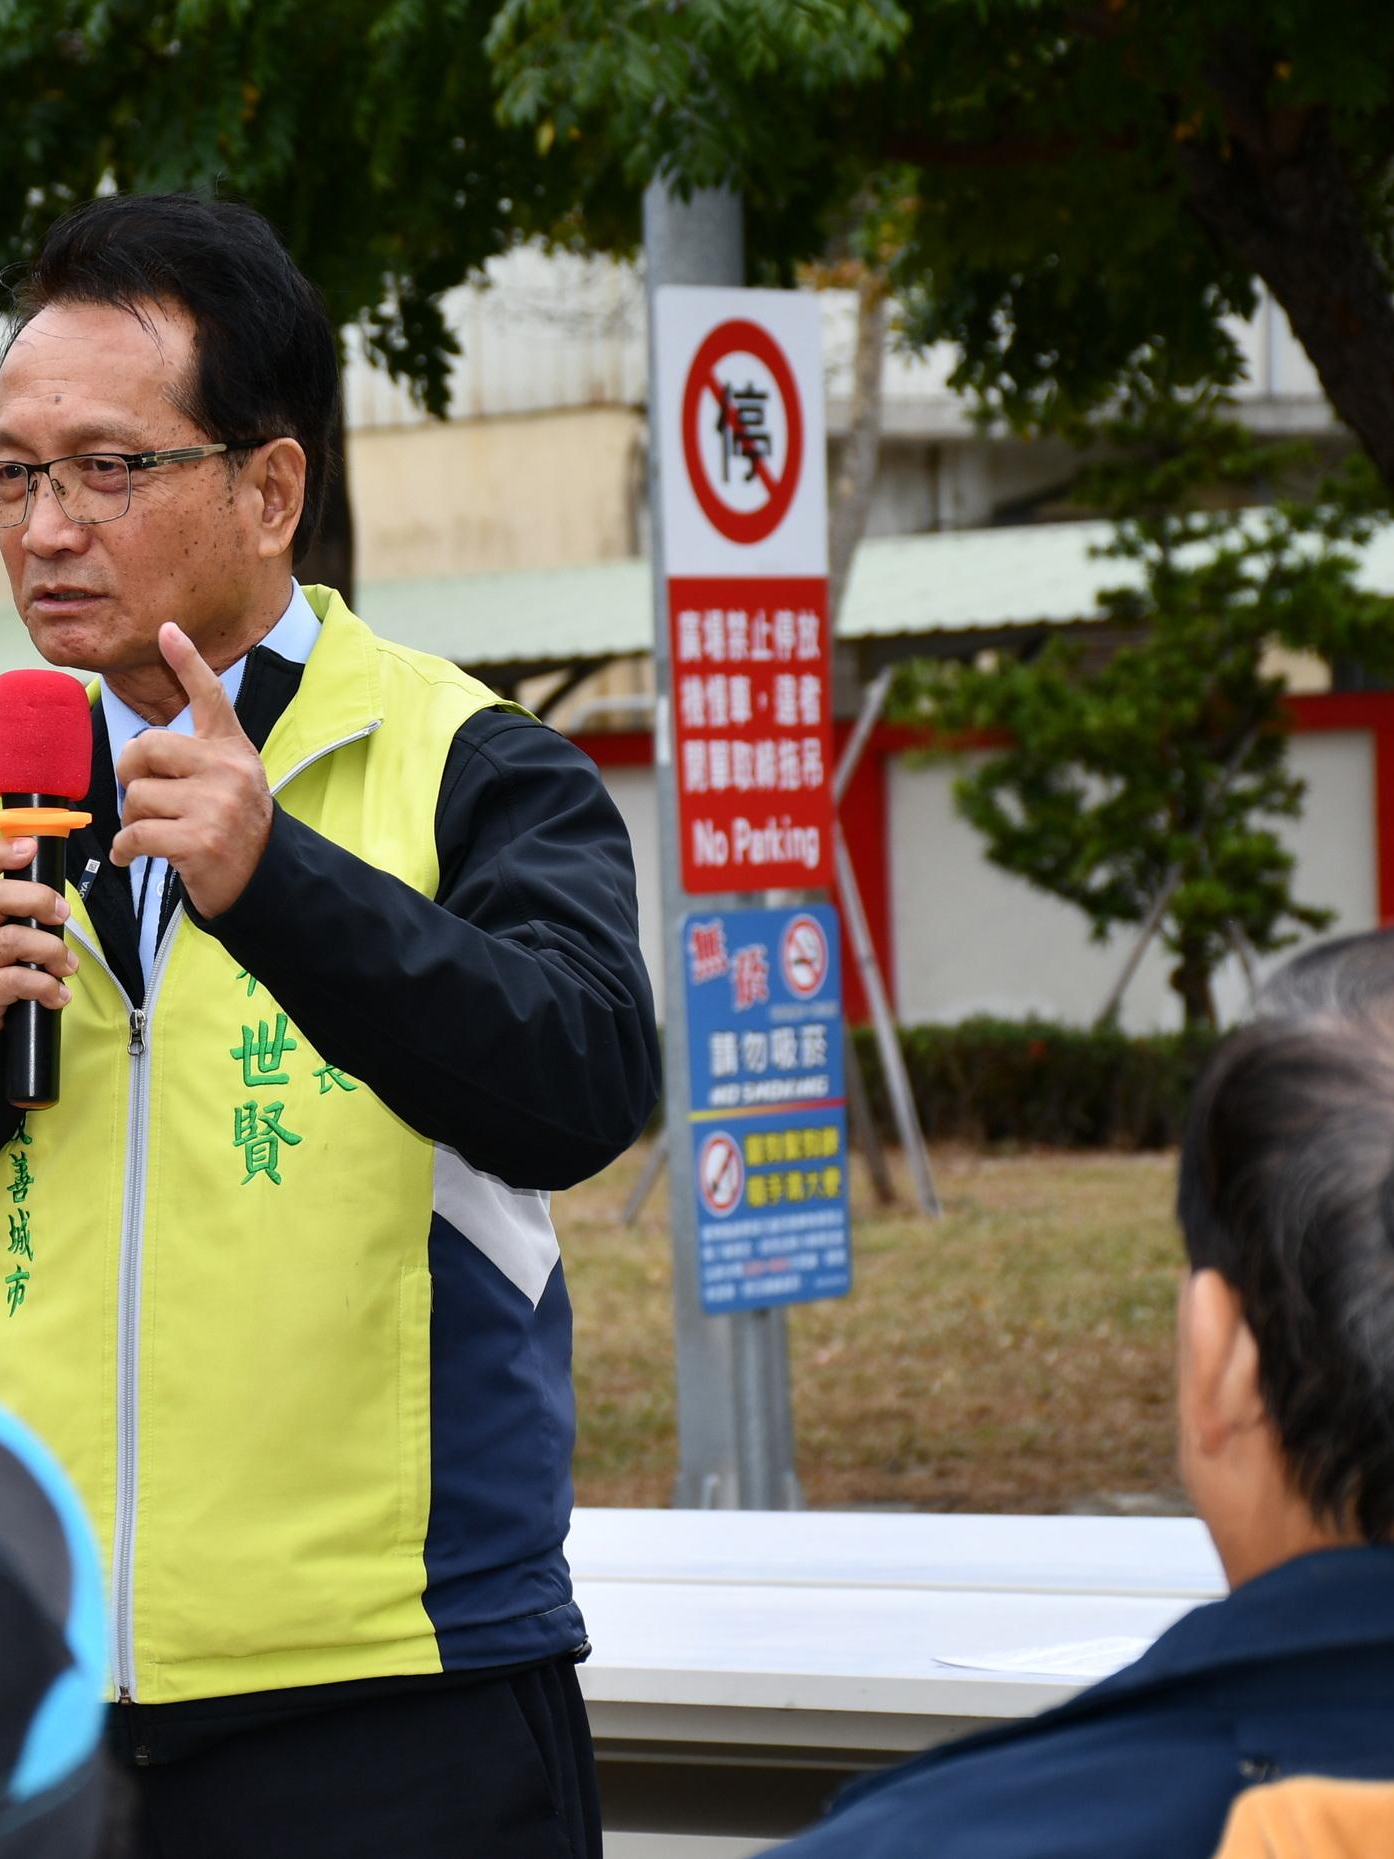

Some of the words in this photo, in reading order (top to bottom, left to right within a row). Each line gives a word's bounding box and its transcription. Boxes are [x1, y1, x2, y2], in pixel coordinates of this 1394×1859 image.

[716, 381, 771, 483] 停
[692, 817, 729, 867] No
[732, 814, 820, 869] Parking
[230, 968, 303, 1186] 世賢
